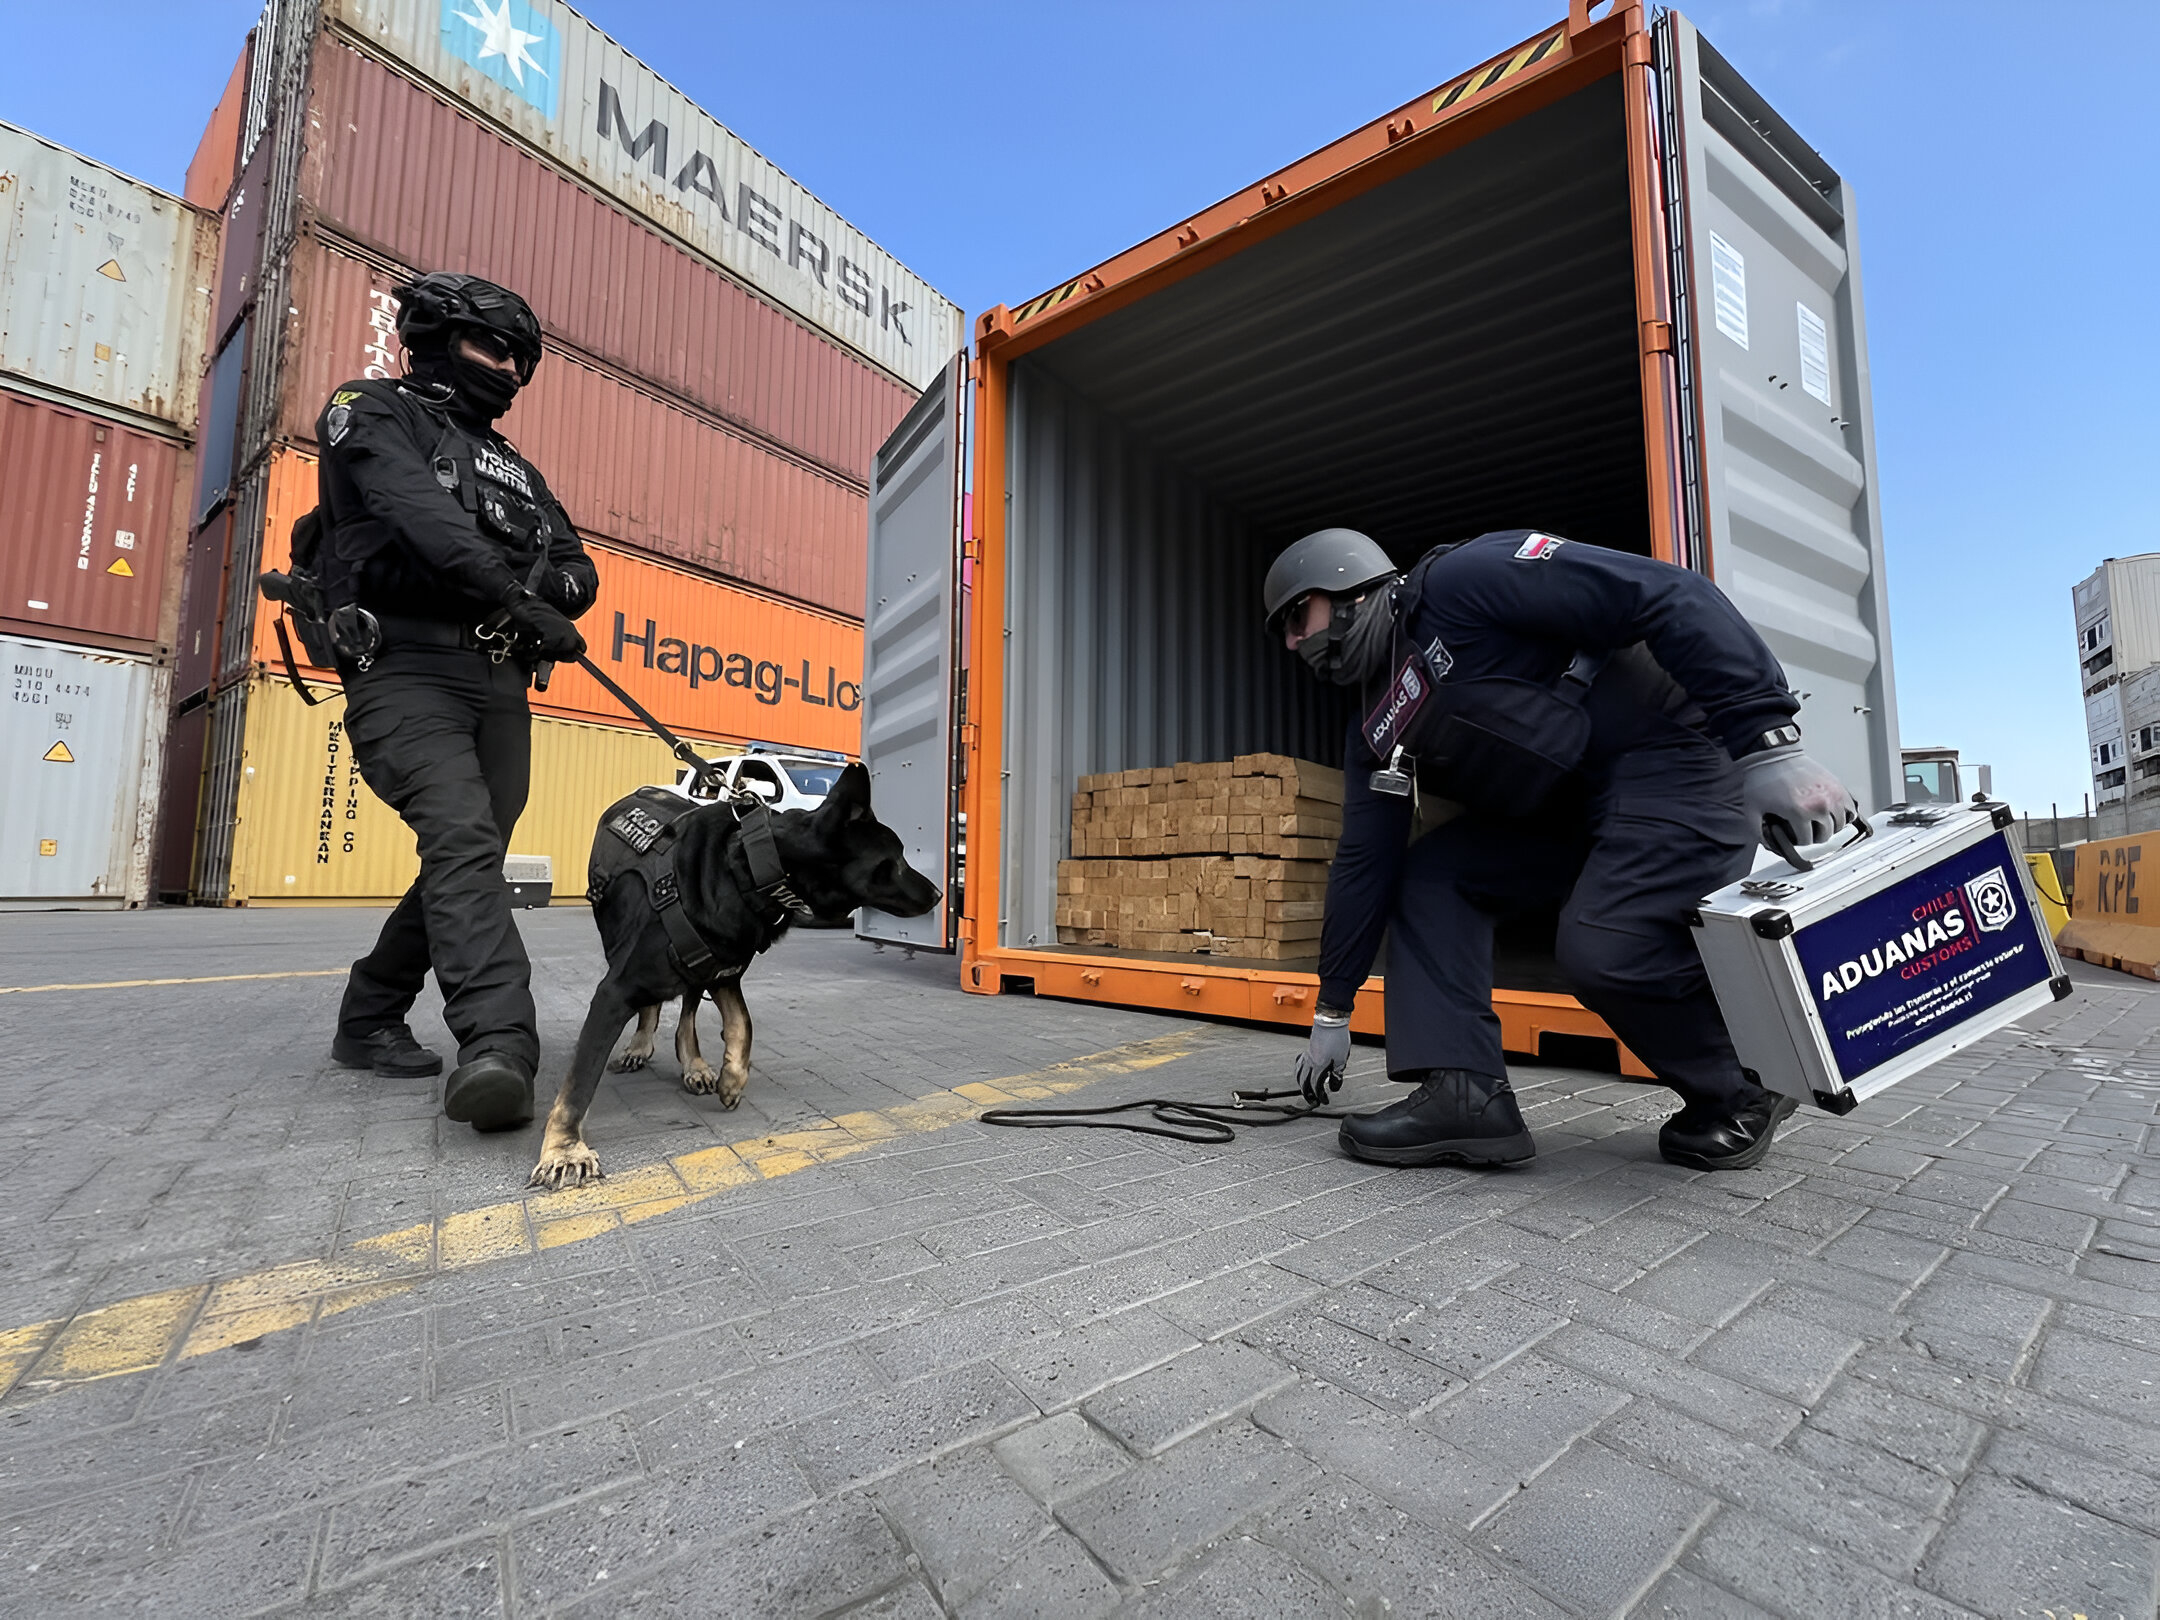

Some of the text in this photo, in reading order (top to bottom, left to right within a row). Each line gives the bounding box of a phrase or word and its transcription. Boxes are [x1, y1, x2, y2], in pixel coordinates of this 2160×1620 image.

[596, 77, 914, 348] MAERSK
[363, 288, 402, 380] TRITO
[611, 610, 862, 712] Hapag-Llo
[316, 720, 343, 864] MEDITERRANEAN
[342, 831, 355, 853] CO
[1911, 889, 1956, 922] CHILE
[1821, 908, 1966, 1001] ADUANAS
[1900, 935, 1974, 981] CUSTOMS
